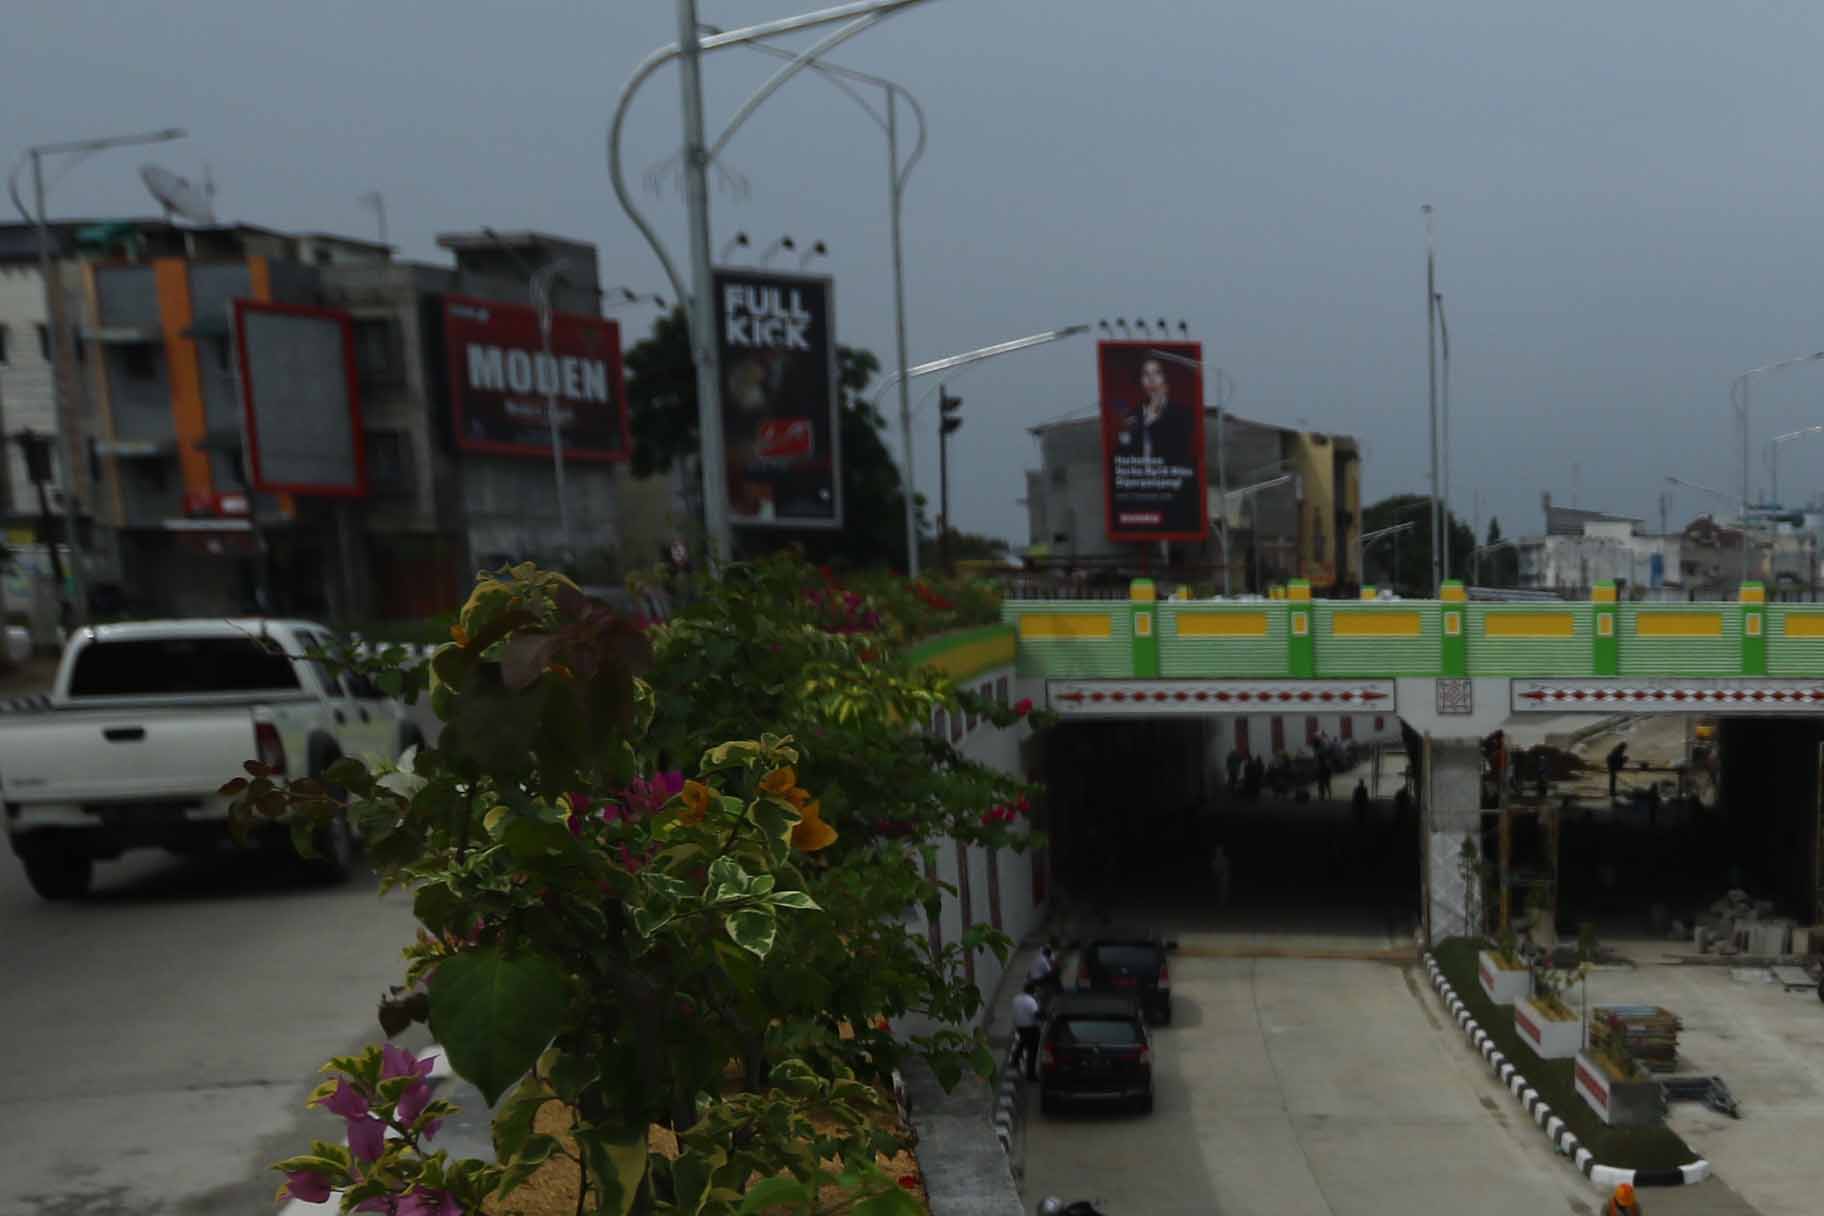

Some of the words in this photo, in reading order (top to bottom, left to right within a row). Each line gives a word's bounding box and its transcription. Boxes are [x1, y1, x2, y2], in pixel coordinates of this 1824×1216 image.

[725, 285, 811, 319] FULL
[727, 318, 810, 349] KICK
[467, 344, 607, 403] MODEN
